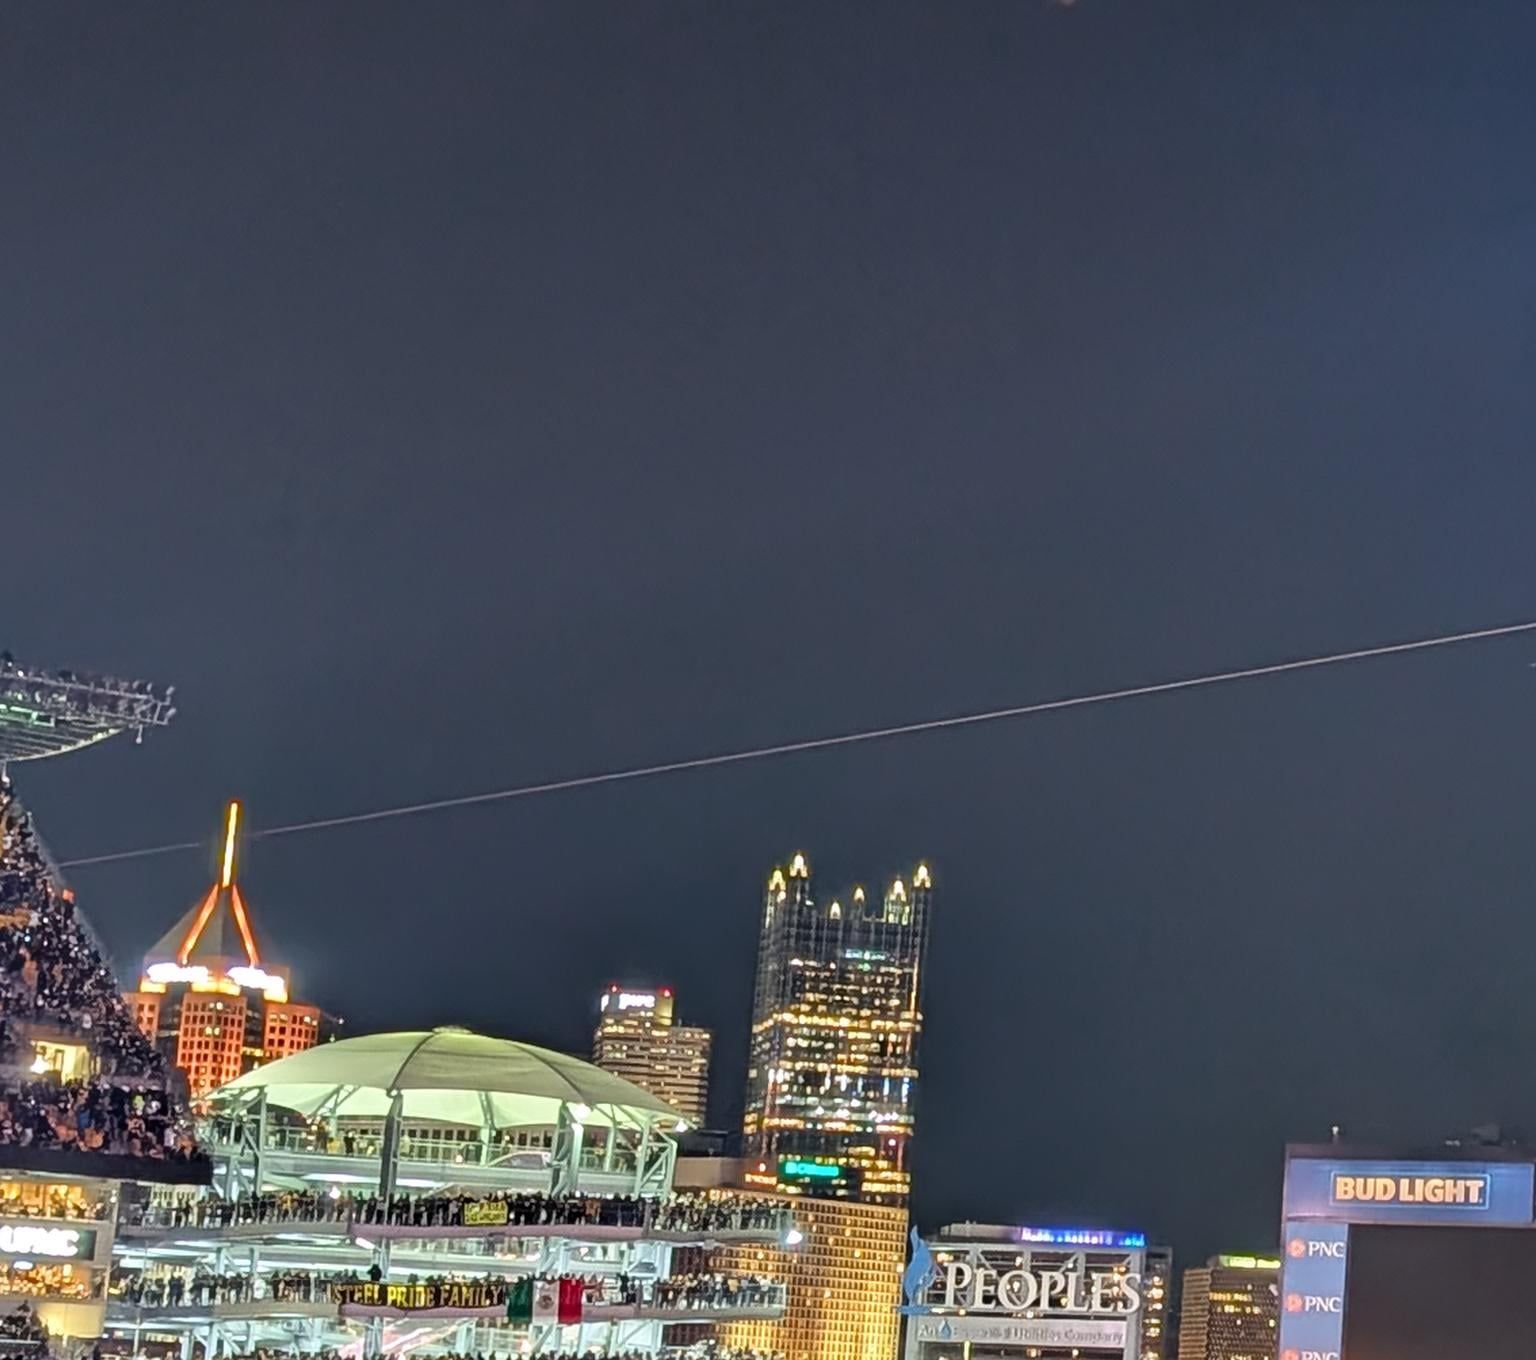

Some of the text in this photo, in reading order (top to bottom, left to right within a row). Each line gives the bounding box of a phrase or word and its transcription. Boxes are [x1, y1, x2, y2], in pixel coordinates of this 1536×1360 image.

[1335, 1177, 1484, 1203] BUD LIGHT
[1308, 1241, 1344, 1257] PNC
[335, 1284, 500, 1308] STEEL PRIDE FAMILY
[944, 1262, 1142, 1314] PEOPLES
[1304, 1296, 1341, 1312] PNC
